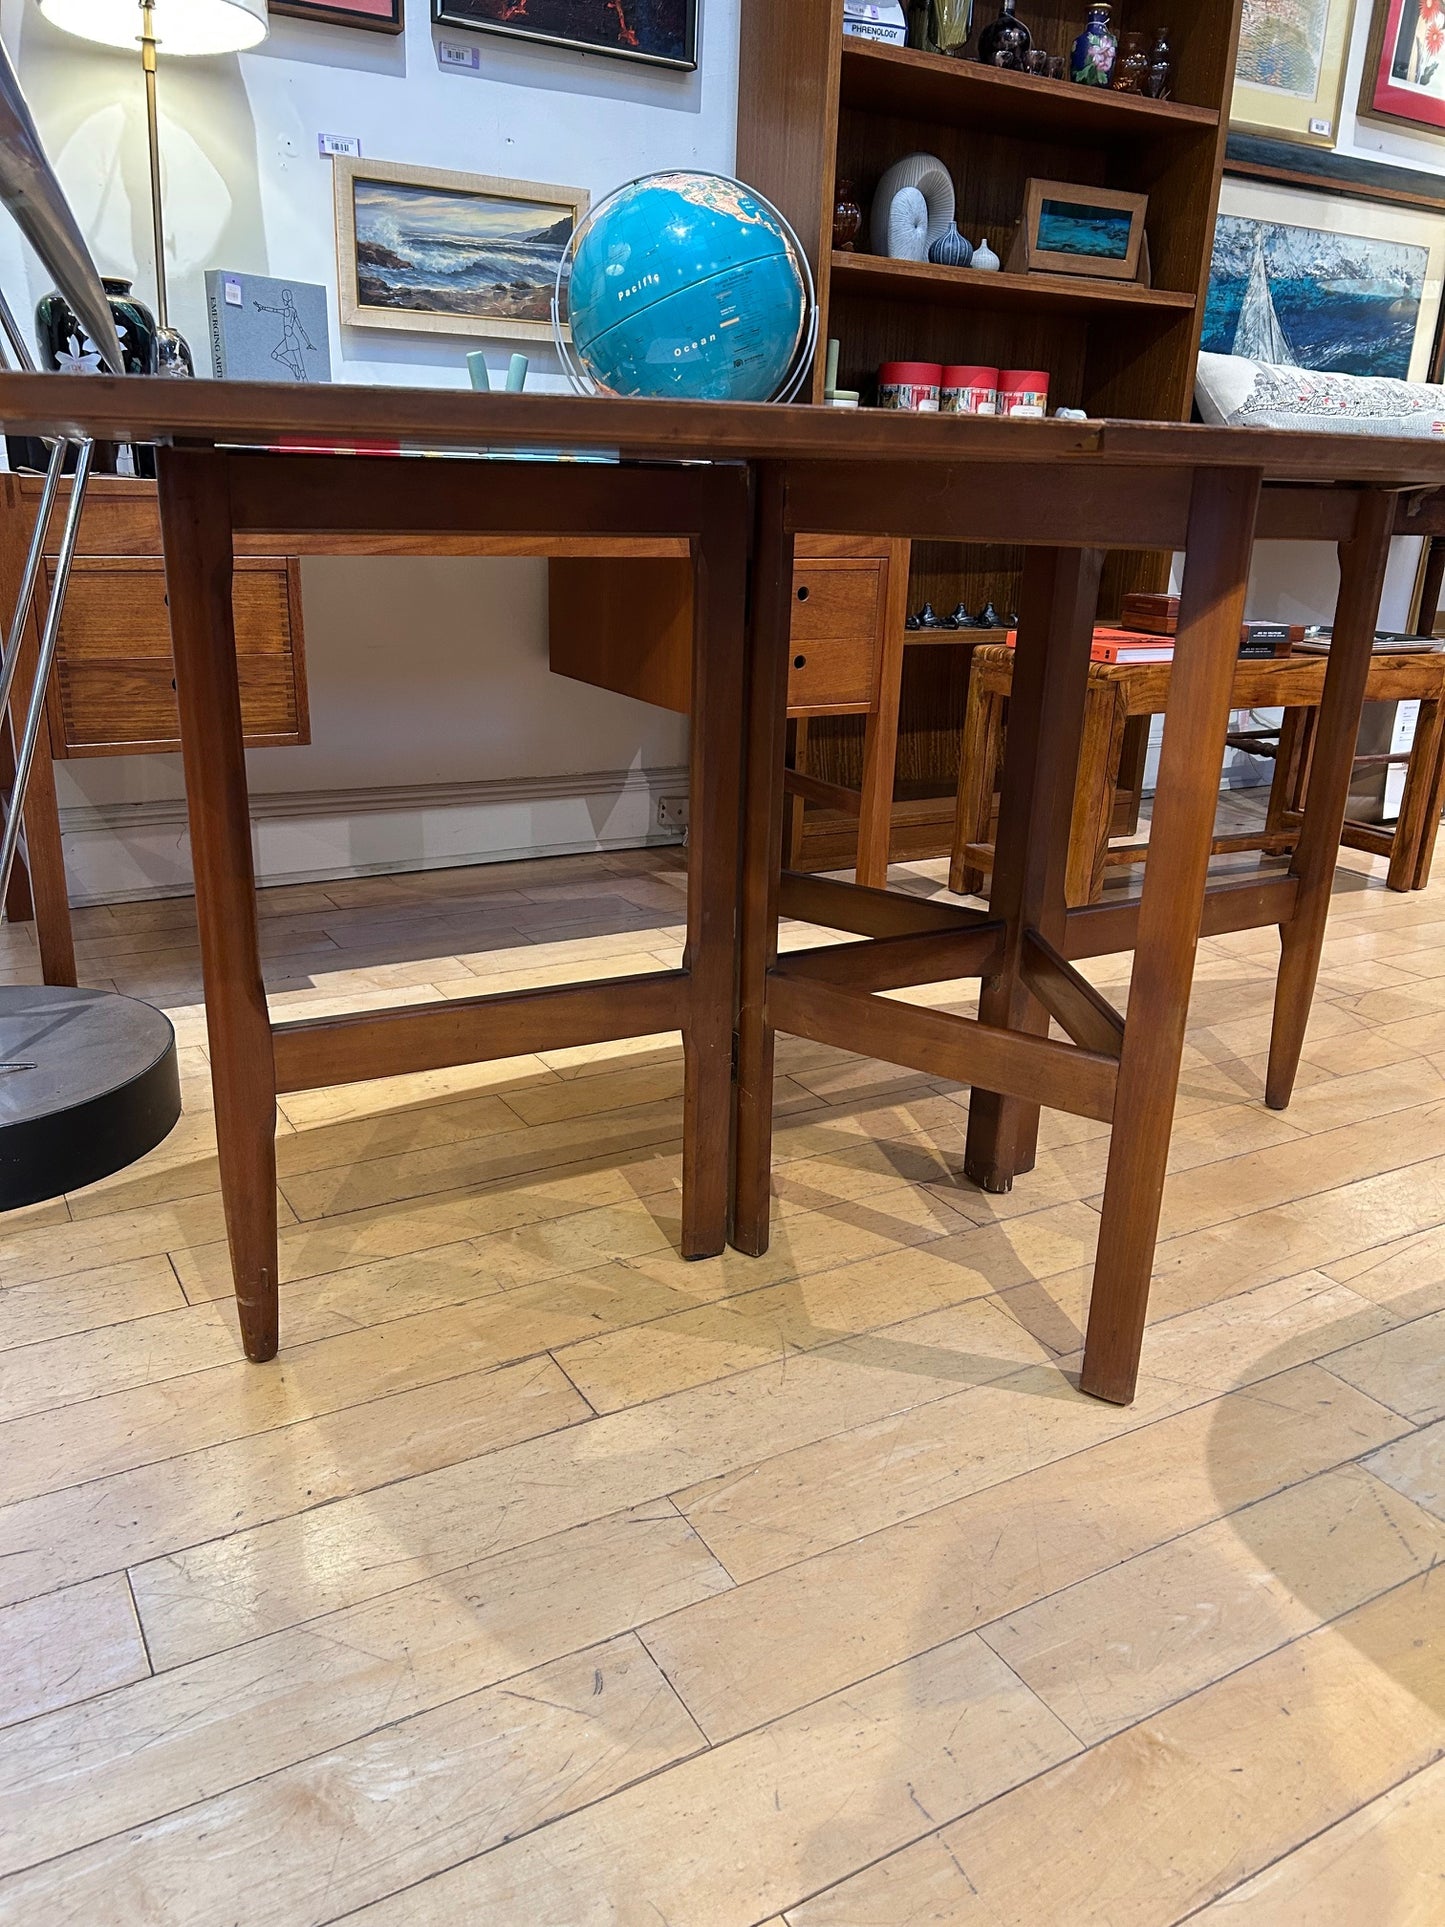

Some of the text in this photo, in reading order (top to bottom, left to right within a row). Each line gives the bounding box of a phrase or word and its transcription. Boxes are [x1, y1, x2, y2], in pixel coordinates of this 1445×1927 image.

[851, 24, 898, 38] PHRENOLOGY
[618, 273, 660, 301] Pacific
[210, 297, 221, 352] EMERGING
[674, 334, 716, 357] Ocean
